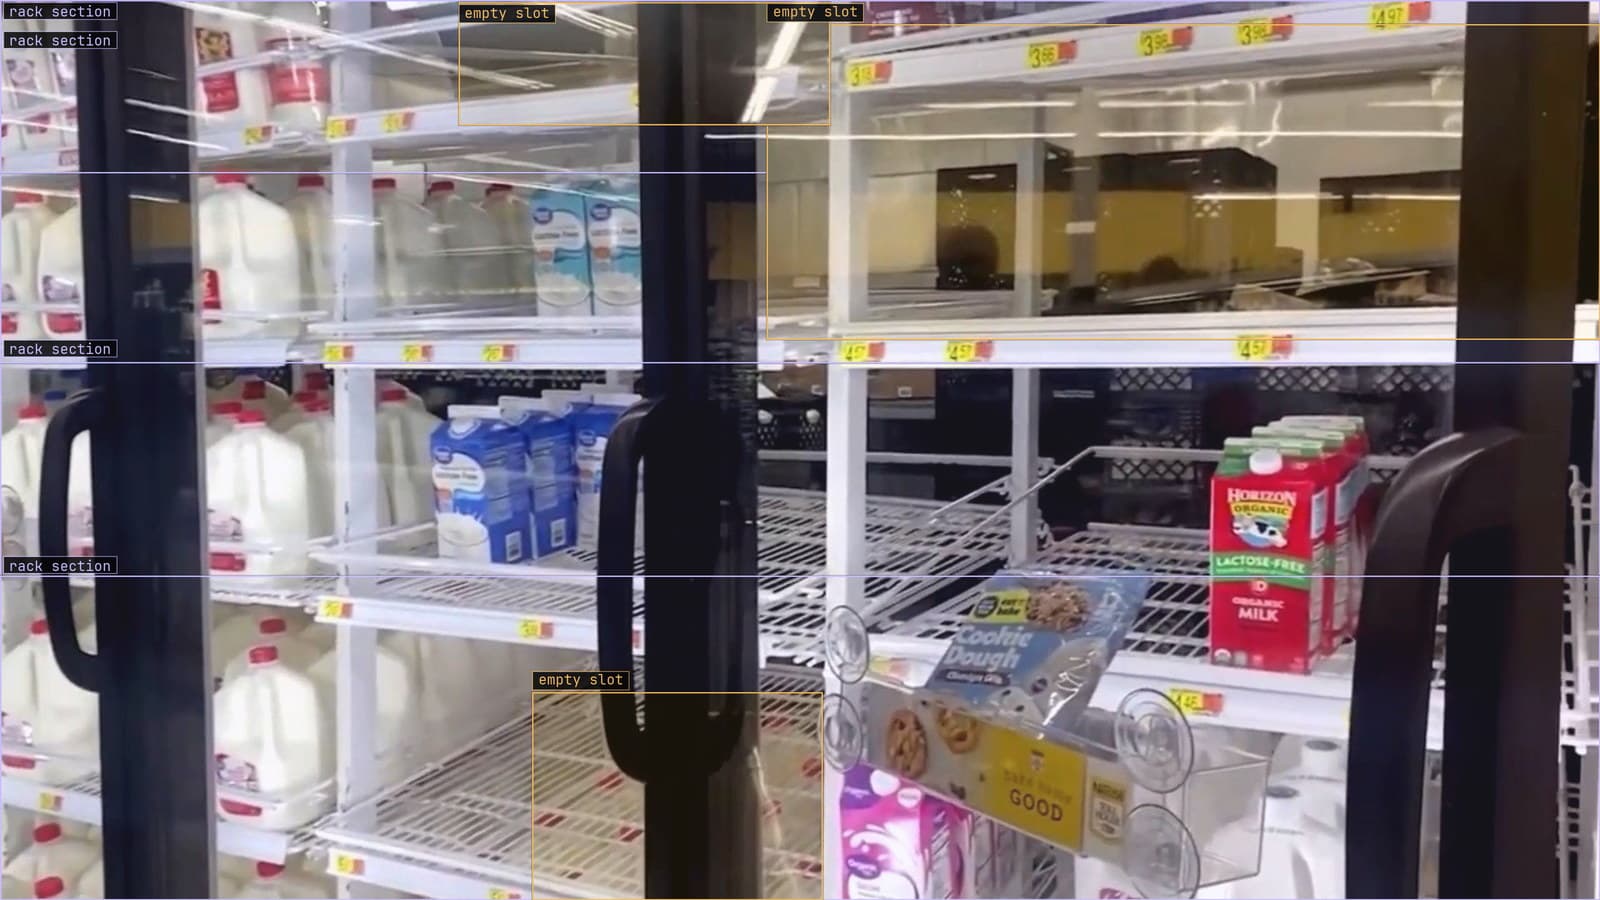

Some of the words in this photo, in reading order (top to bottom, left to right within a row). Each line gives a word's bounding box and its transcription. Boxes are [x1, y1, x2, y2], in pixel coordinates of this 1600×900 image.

[1227, 487, 1298, 506] HORIZON
[1233, 503, 1289, 516] ORGANIC
[1216, 554, 1306, 575] LACTOSE-FREE
[1231, 596, 1285, 609] ORGANIC
[1238, 606, 1279, 623] MILK
[956, 625, 1034, 648] Cookie
[942, 645, 1022, 673] Dough
[1009, 787, 1063, 822] GOOD
